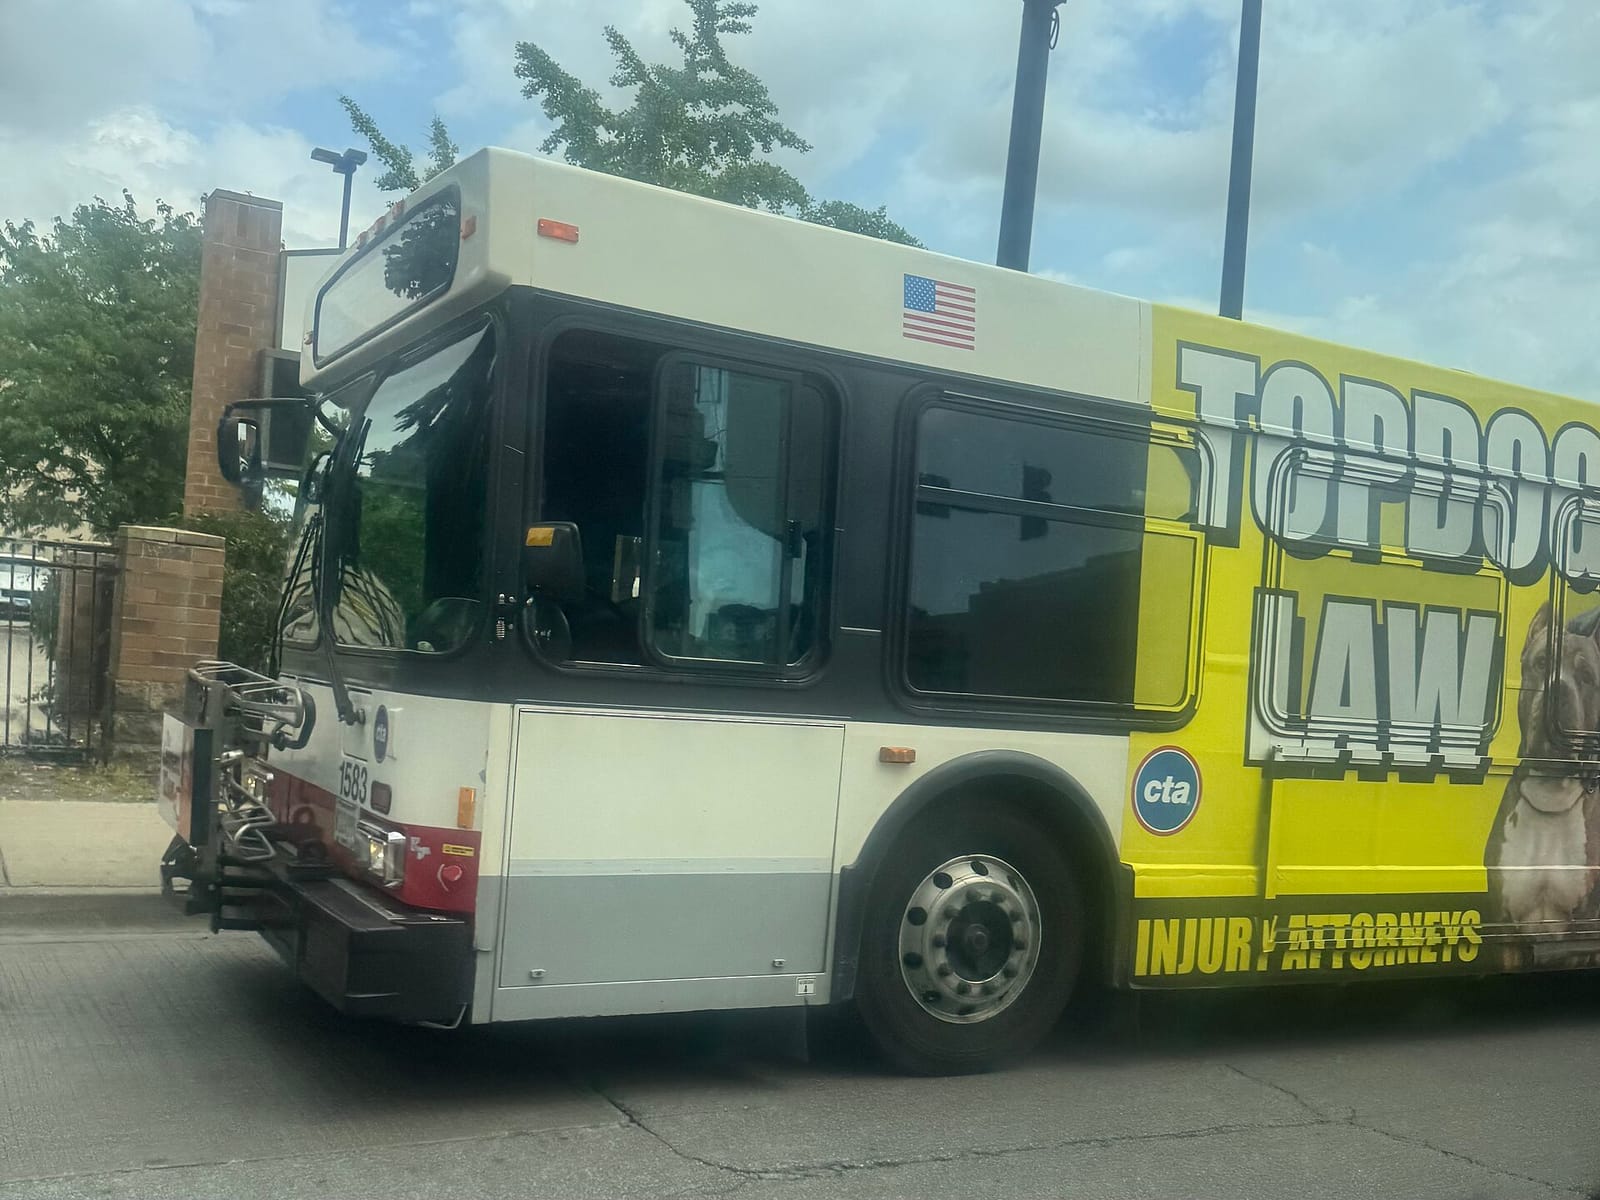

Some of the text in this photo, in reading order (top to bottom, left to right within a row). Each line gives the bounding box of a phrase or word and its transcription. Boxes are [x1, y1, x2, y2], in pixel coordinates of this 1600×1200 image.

[1244, 586, 1502, 784] LAW
[339, 760, 368, 804] 1583
[1142, 774, 1191, 805] cta
[1134, 909, 1482, 977] INJURY ATTORNEYS
